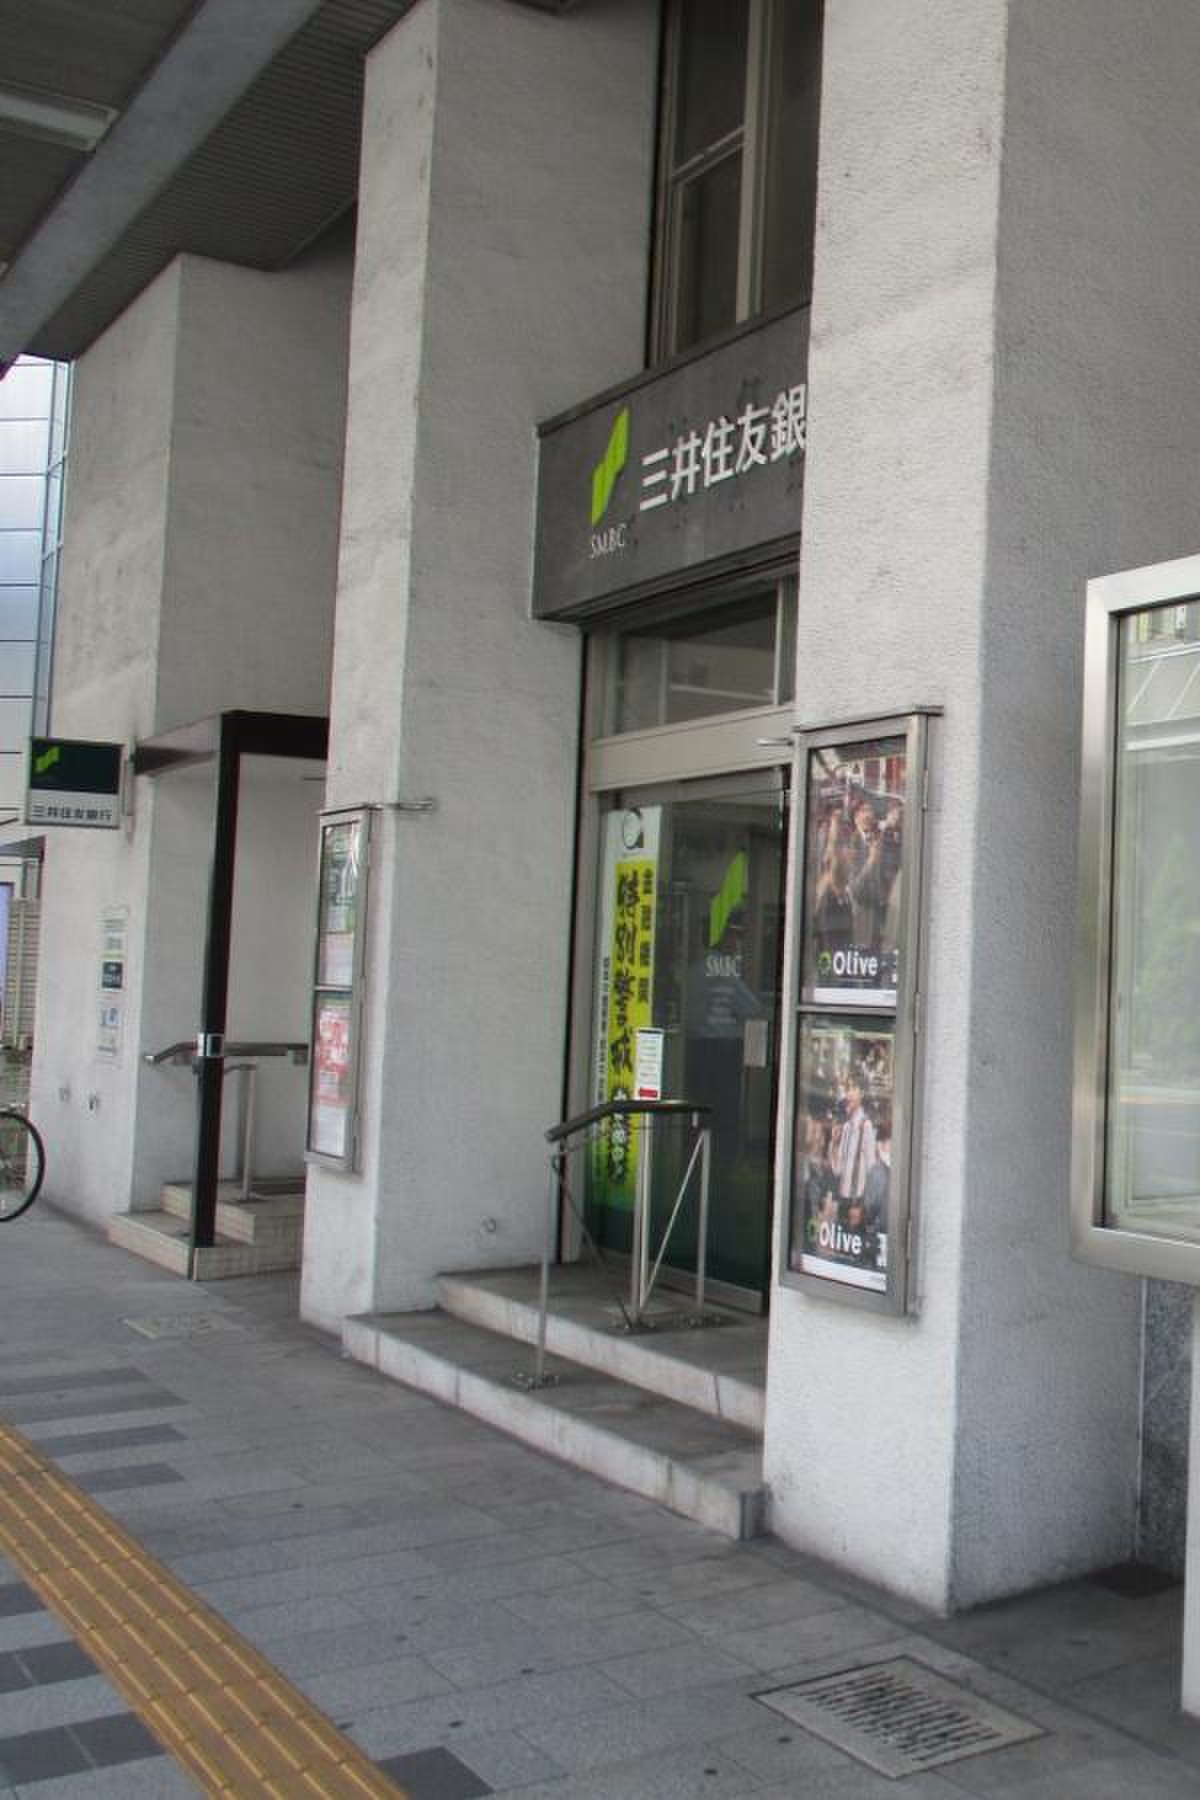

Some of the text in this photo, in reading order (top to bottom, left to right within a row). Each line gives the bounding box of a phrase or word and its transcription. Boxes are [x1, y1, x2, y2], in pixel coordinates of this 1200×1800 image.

[587, 522, 627, 560] SMBC
[832, 950, 879, 977] Olive
[819, 1221, 863, 1255] Olive
